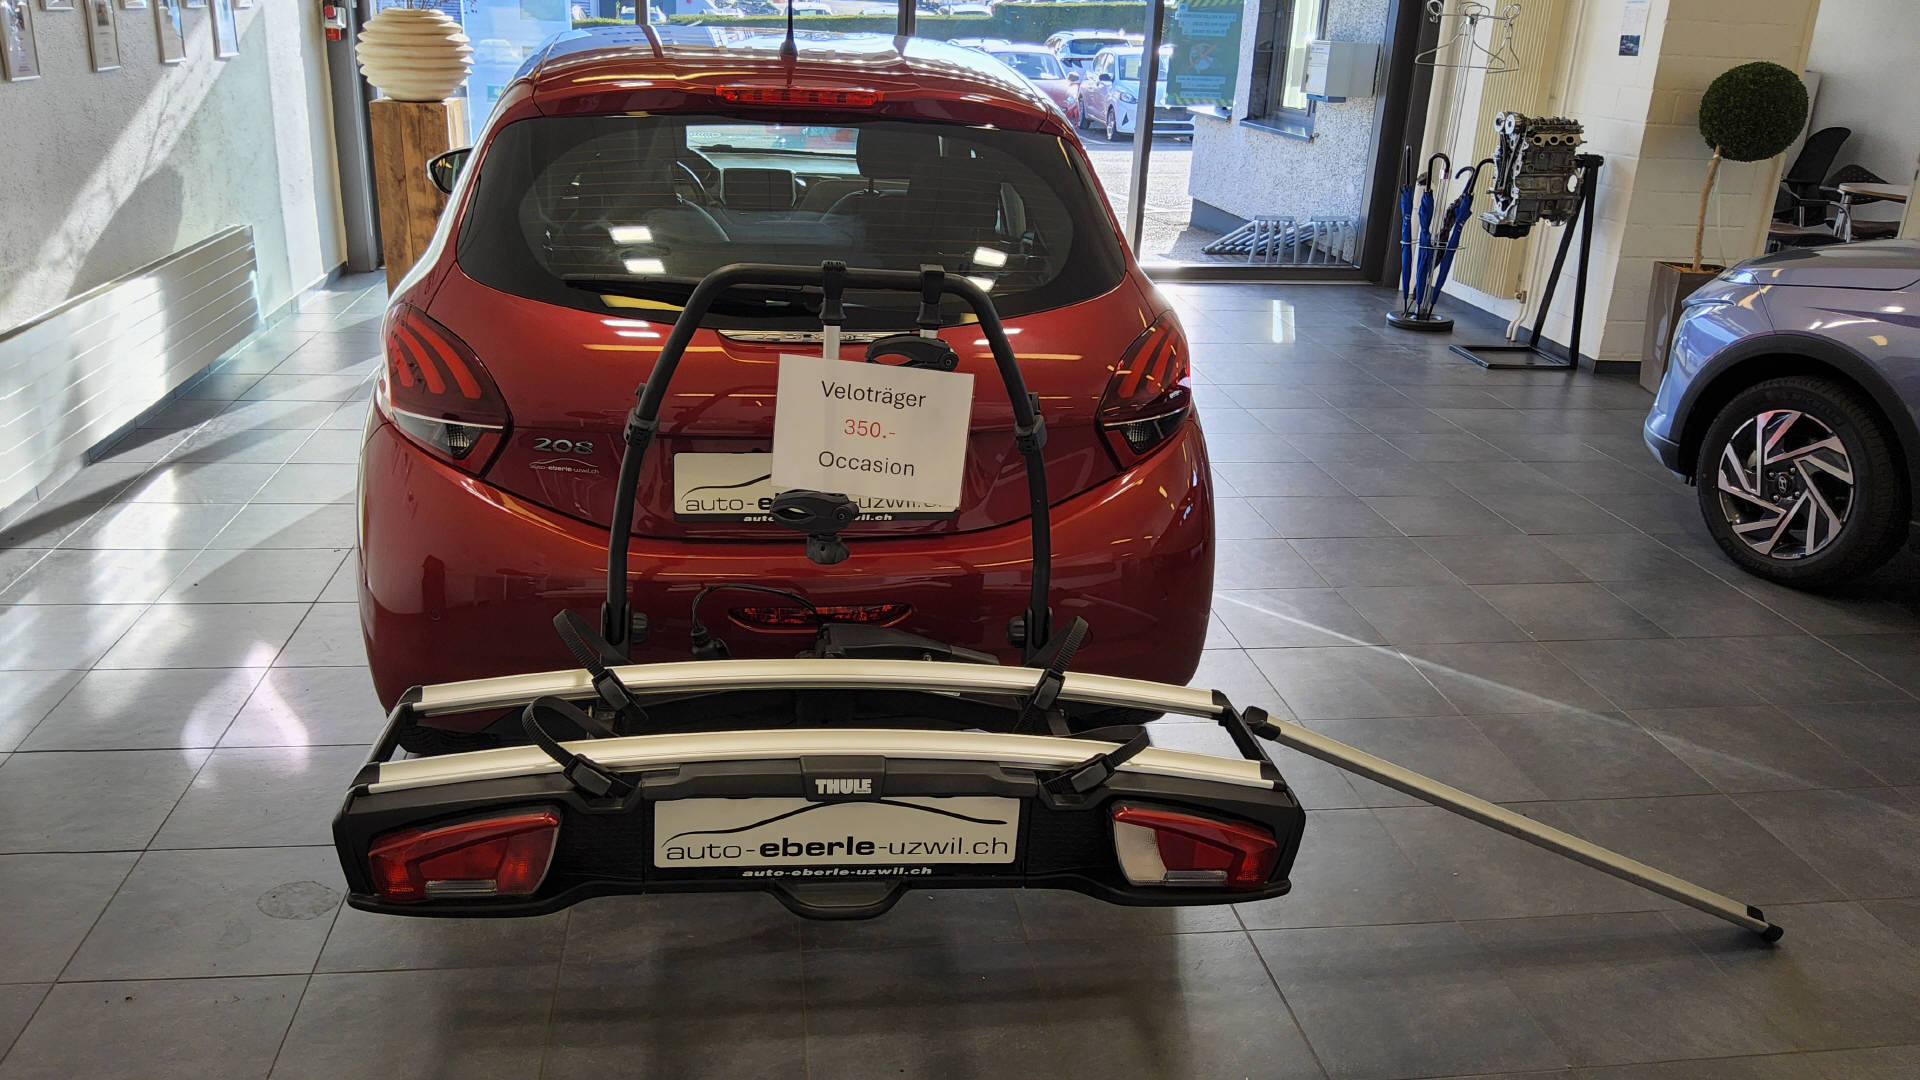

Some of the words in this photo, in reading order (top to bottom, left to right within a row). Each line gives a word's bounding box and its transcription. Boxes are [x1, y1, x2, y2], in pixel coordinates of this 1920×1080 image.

[821, 380, 927, 410] Veloträger
[843, 418, 896, 439] 350.-
[533, 437, 594, 455] 208
[818, 451, 915, 477] Occasion
[815, 778, 872, 795] THULE
[666, 835, 1009, 860] auto-eberle-uzwil.ch
[742, 867, 932, 877] auto-eberle-uzwil.ch
